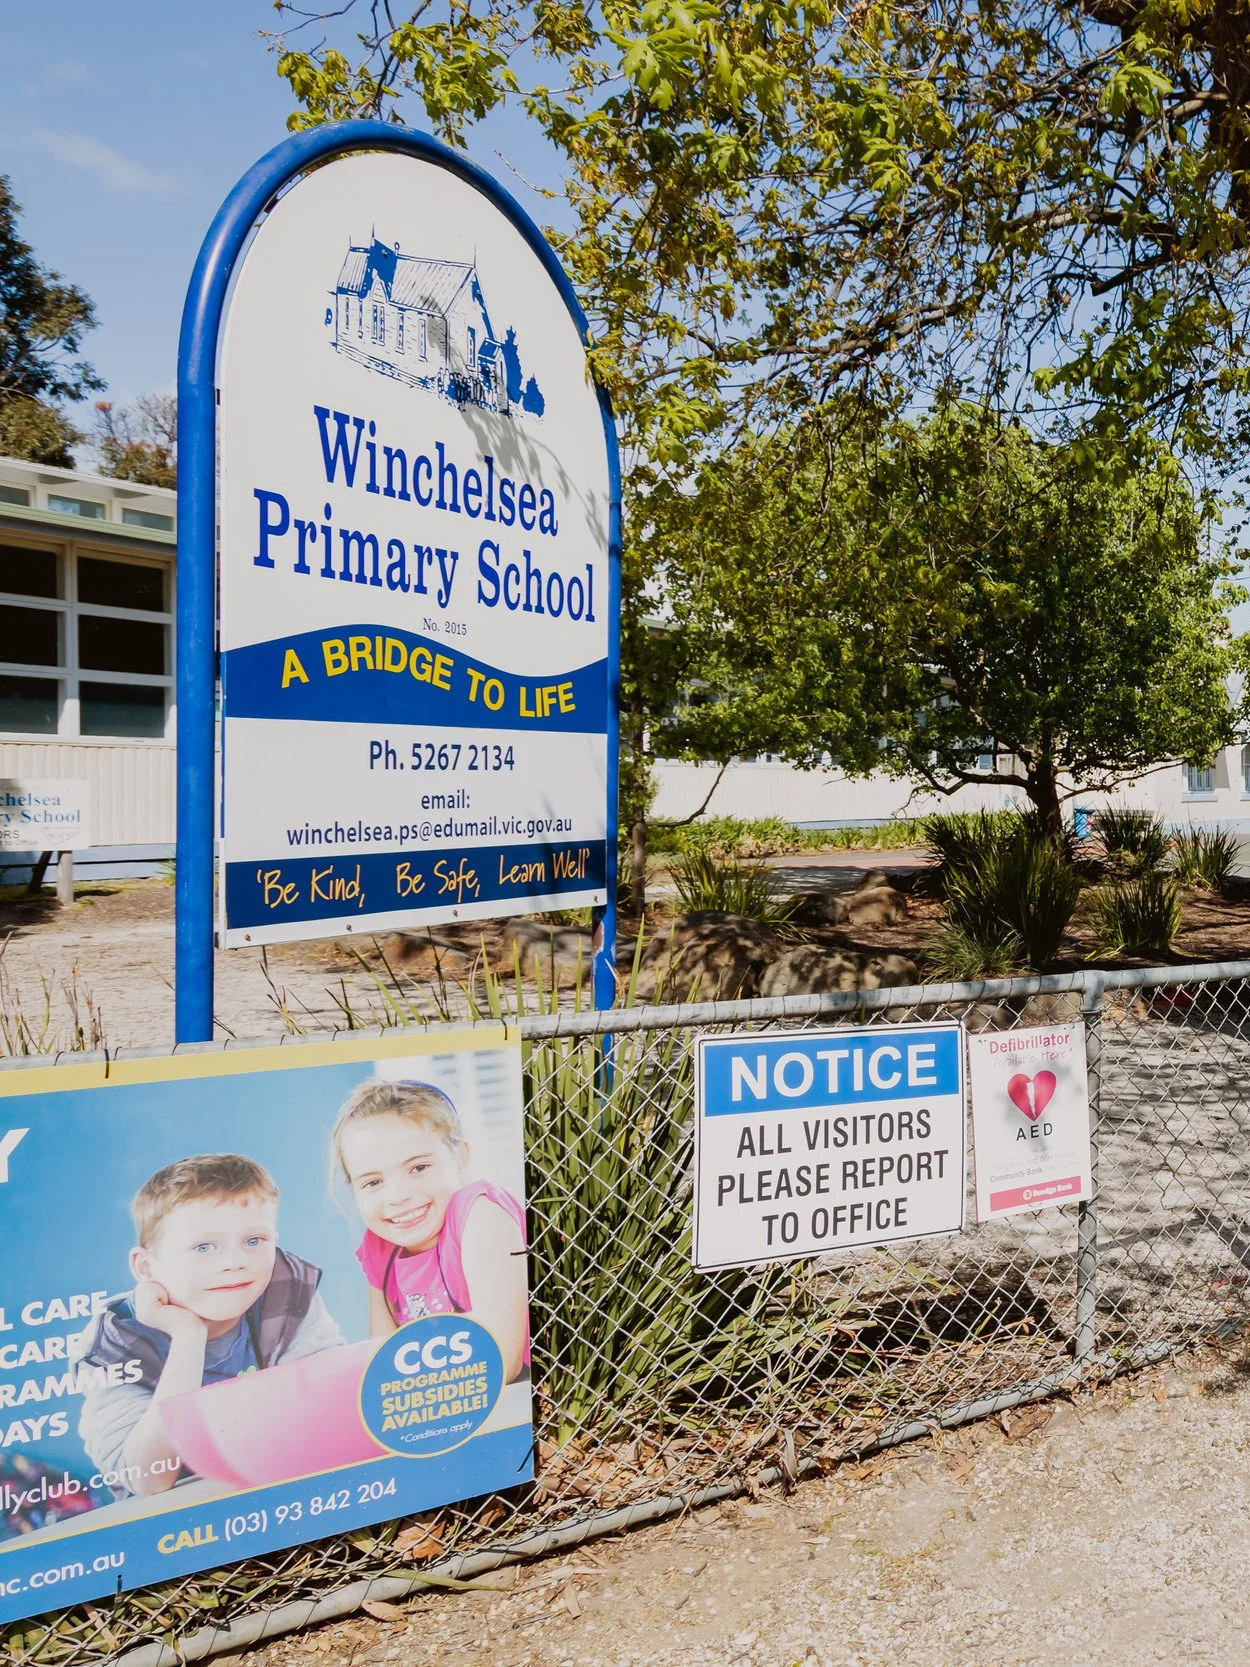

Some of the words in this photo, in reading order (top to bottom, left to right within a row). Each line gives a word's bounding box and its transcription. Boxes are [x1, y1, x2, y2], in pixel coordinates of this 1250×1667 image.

[314, 405, 559, 537] Winchelsea
[253, 488, 459, 609] Primary
[477, 539, 595, 623] School
[423, 618, 441, 633] No.
[445, 621, 467, 636] 2015
[281, 649, 309, 689] A
[322, 635, 454, 691] BRIDGE
[467, 668, 505, 711] TO
[519, 682, 576, 718] LIFE
[369, 740, 405, 771] Ph.
[411, 744, 462, 772] 5267
[467, 745, 515, 772] 2134
[21, 809, 80, 823] School
[421, 790, 471, 811] email:
[287, 813, 572, 847] winchelsea.ps@edumail.vic.gov.au
[310, 864, 366, 908] Kind,
[396, 862, 425, 895] Be
[433, 859, 480, 904] Safe,
[498, 855, 546, 886] Learn
[990, 1033, 1069, 1054] Defibrillator
[731, 1043, 936, 1102] NOTICE
[737, 1123, 792, 1158] ALL
[803, 1109, 931, 1151] VISITORS
[718, 1163, 829, 1207] PLEASE
[842, 1150, 948, 1191] REPORT
[990, 1168, 1025, 1184] Community
[1027, 1167, 1042, 1177] Bank
[762, 1213, 799, 1246] TO
[811, 1197, 908, 1239] OFFICE
[21, 1291, 107, 1326] CARE
[394, 1331, 472, 1374] CCS
[380, 1361, 487, 1396] PROGRAMME
[382, 1377, 488, 1415] SUBSIDIES
[0, 1411, 69, 1448] AYS
[382, 1394, 488, 1432] AVAILABLE!
[450, 1419, 473, 1433] apply
[157, 1524, 219, 1554] CALL
[224, 1509, 268, 1541] (03)
[275, 1502, 302, 1525] 93
[310, 1489, 350, 1516] 842
[357, 1477, 397, 1505] 204
